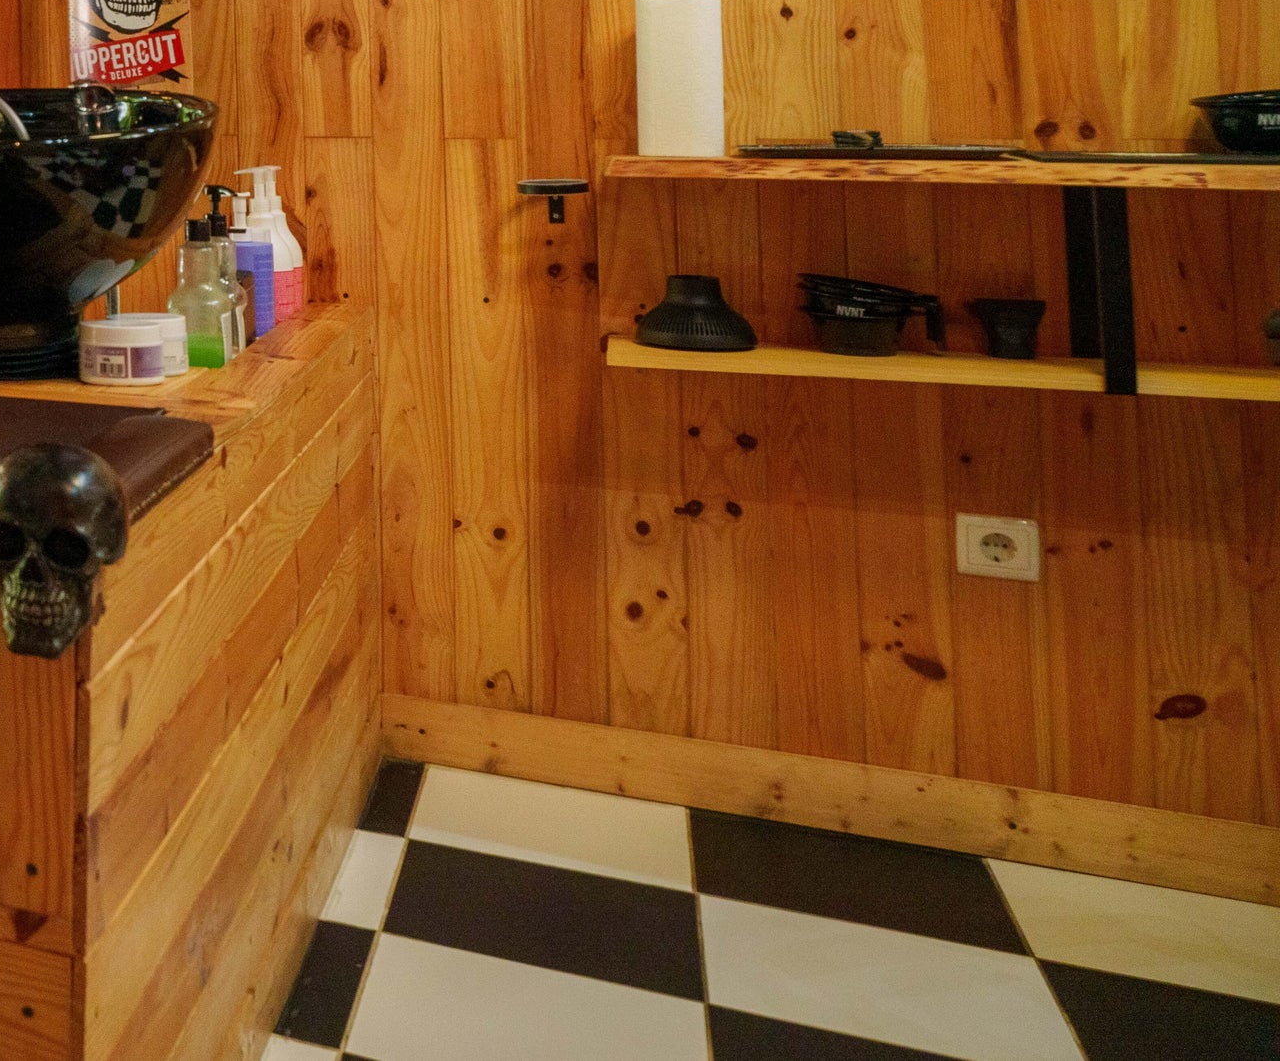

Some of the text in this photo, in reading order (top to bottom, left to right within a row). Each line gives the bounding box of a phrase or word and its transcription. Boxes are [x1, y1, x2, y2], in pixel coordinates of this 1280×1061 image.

[73, 33, 177, 80] UPPERCUT
[109, 66, 143, 81] DELUXE
[836, 305, 865, 318] NVNT
